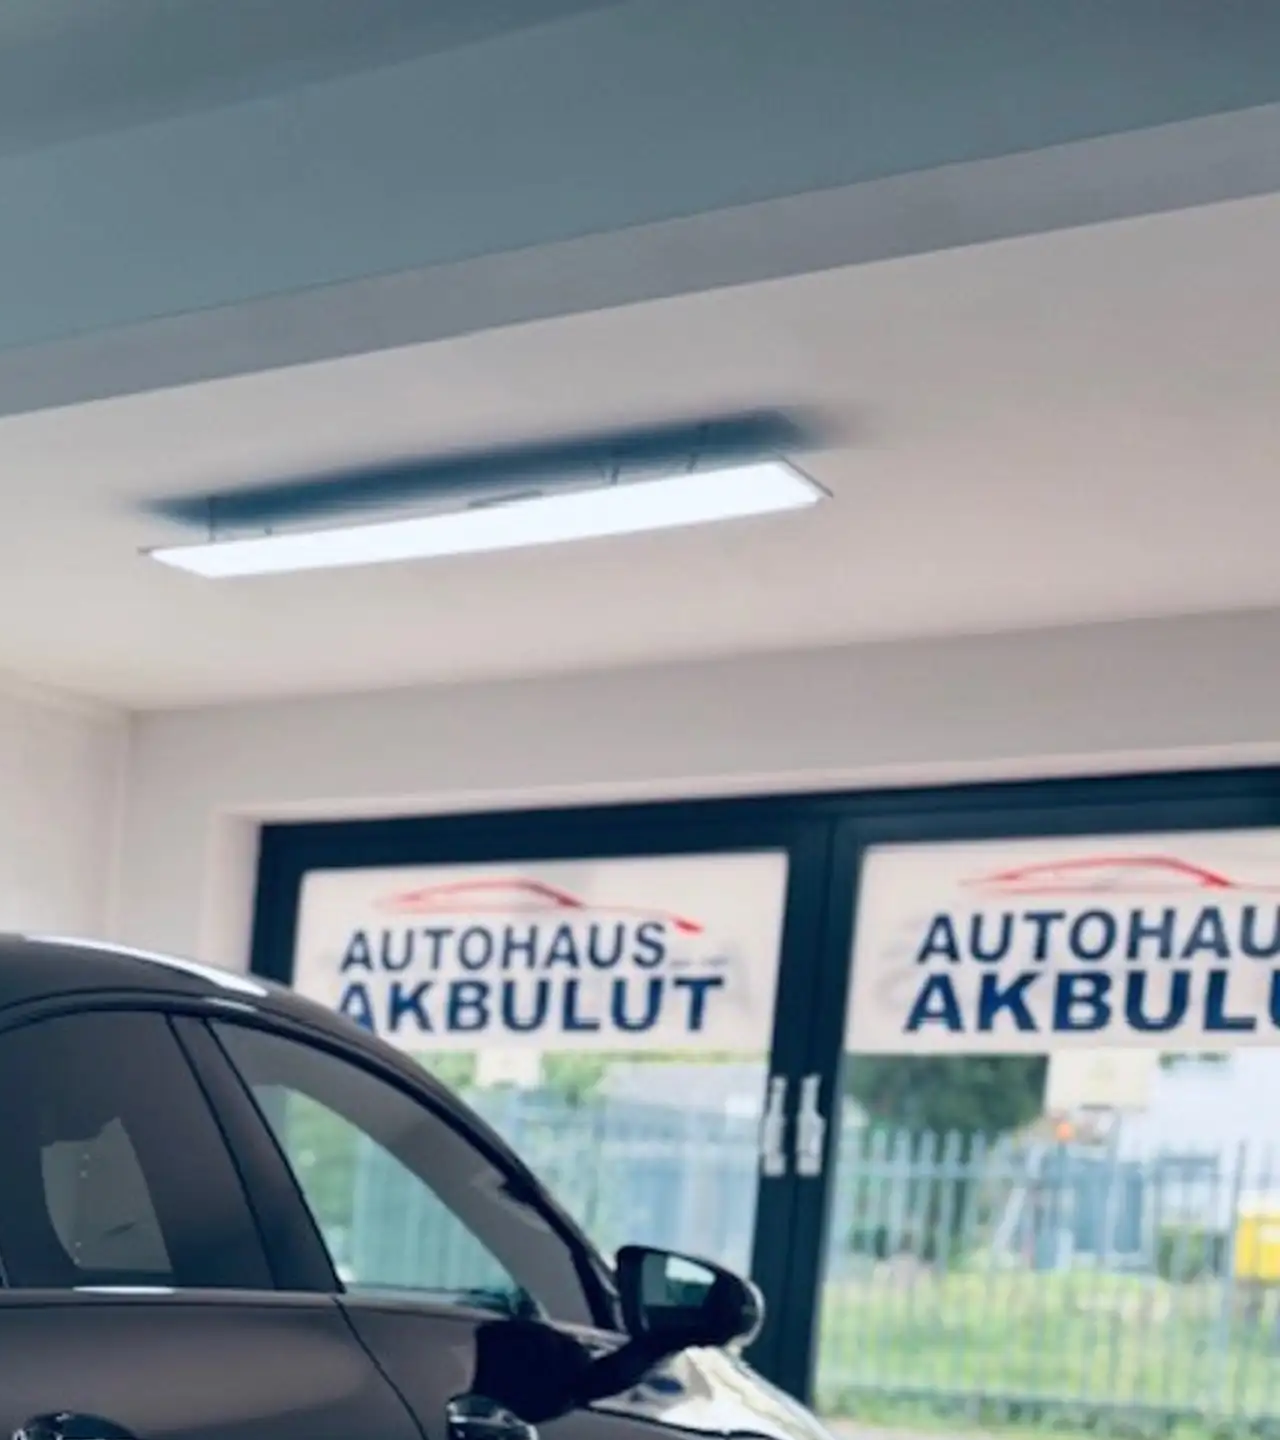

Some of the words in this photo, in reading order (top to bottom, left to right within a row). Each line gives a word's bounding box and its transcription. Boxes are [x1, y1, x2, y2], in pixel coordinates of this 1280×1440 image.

[340, 920, 667, 973] AUTOHAUS
[915, 904, 1280, 964] AUTOHAU
[339, 976, 724, 1034] AKBULUT
[903, 968, 1280, 1034] AKBUL
